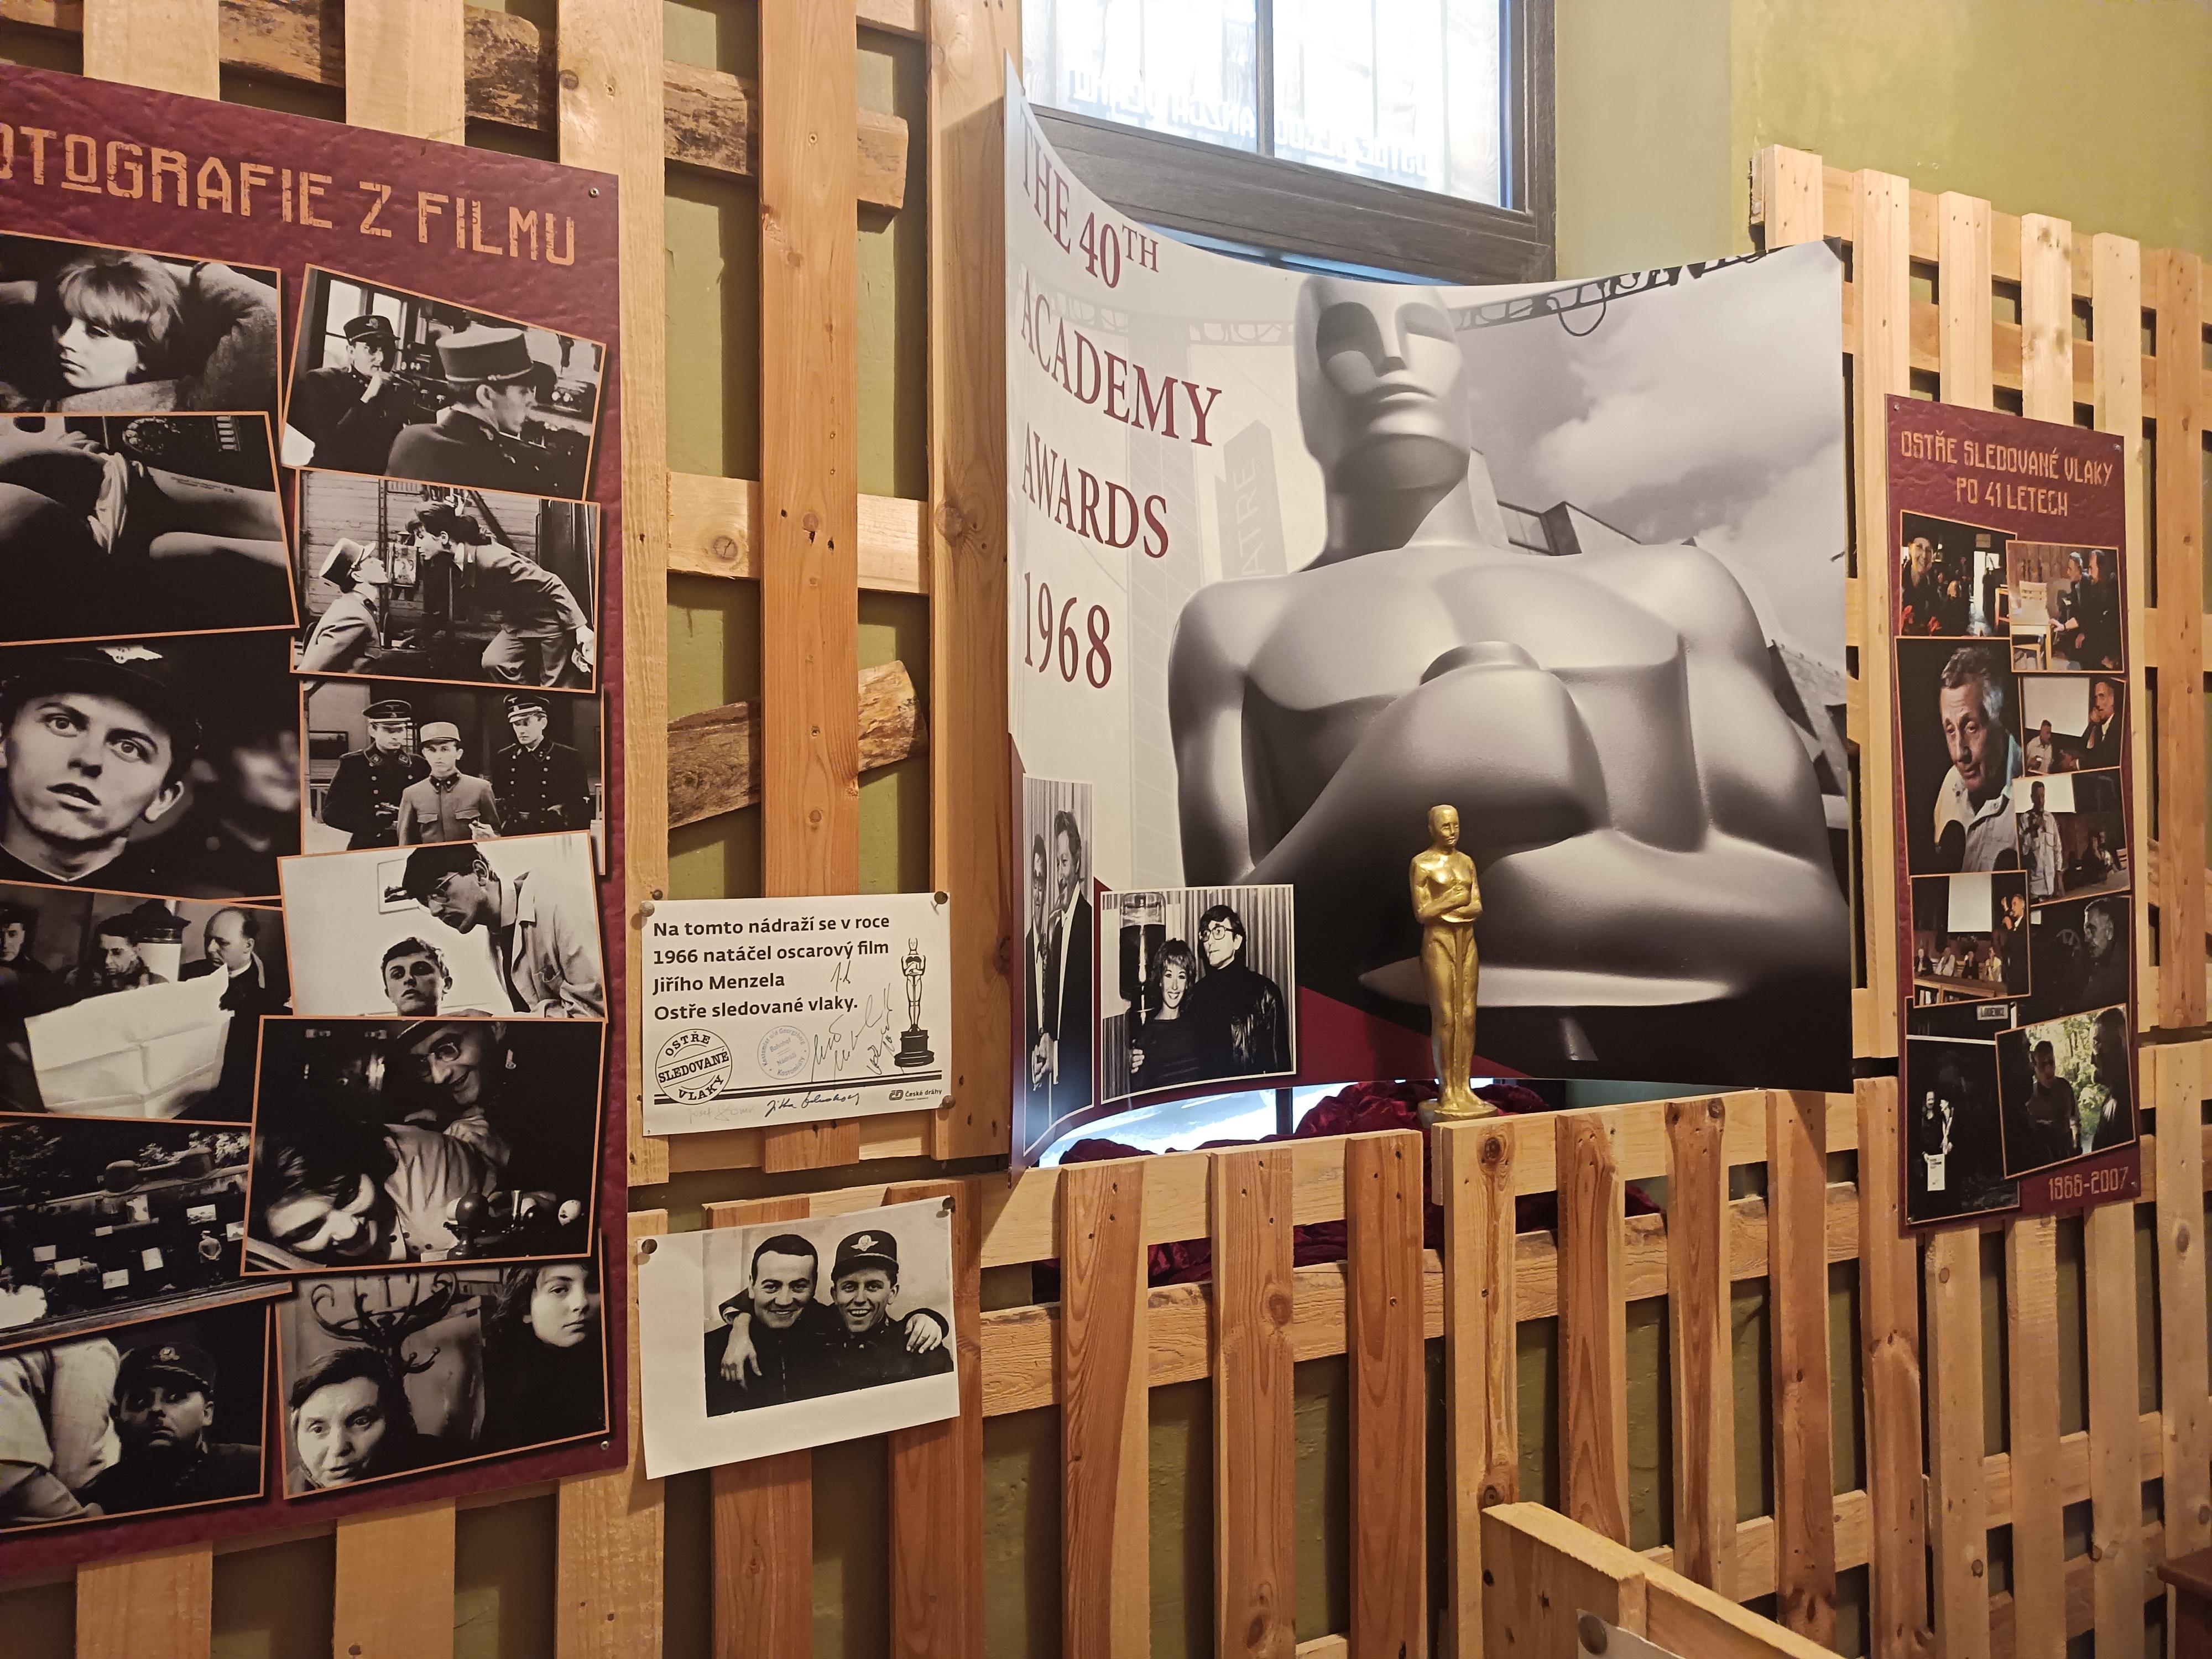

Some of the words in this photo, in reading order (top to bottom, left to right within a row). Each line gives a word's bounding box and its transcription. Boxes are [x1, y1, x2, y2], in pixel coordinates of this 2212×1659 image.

[1020, 101, 1071, 255] THE
[358, 181, 393, 238] Z
[418, 191, 576, 267] FILMU
[1021, 270, 1222, 446] ACADEMY
[1901, 429, 1958, 465] OSTŘE
[1963, 441, 2059, 479] SLEDOVANÉ
[2064, 457, 2114, 487] VLAKY
[1022, 422, 1169, 559] AWARDS
[1957, 476, 1979, 505] PO
[2006, 484, 2068, 517] LETECH
[1024, 571, 1112, 689] 1968
[654, 922, 679, 937] Na
[684, 921, 743, 936] tomto
[749, 916, 815, 933] nádraží
[818, 920, 836, 931] se
[841, 919, 851, 929] v
[855, 917, 889, 928] roce
[654, 949, 698, 964] 1966
[703, 945, 771, 962] natáčel
[777, 941, 853, 959] oscarový
[857, 940, 889, 955] film
[652, 975, 703, 996] Jiřího
[709, 972, 785, 990] Menzela
[654, 1003, 707, 1020] Ostře
[712, 997, 804, 1018] sledované
[808, 995, 858, 1013] vlaky.
[665, 1031, 711, 1056] OSTŘE
[658, 1048, 729, 1083] SLEDOVANÉ
[678, 1074, 724, 1100] VLAKY
